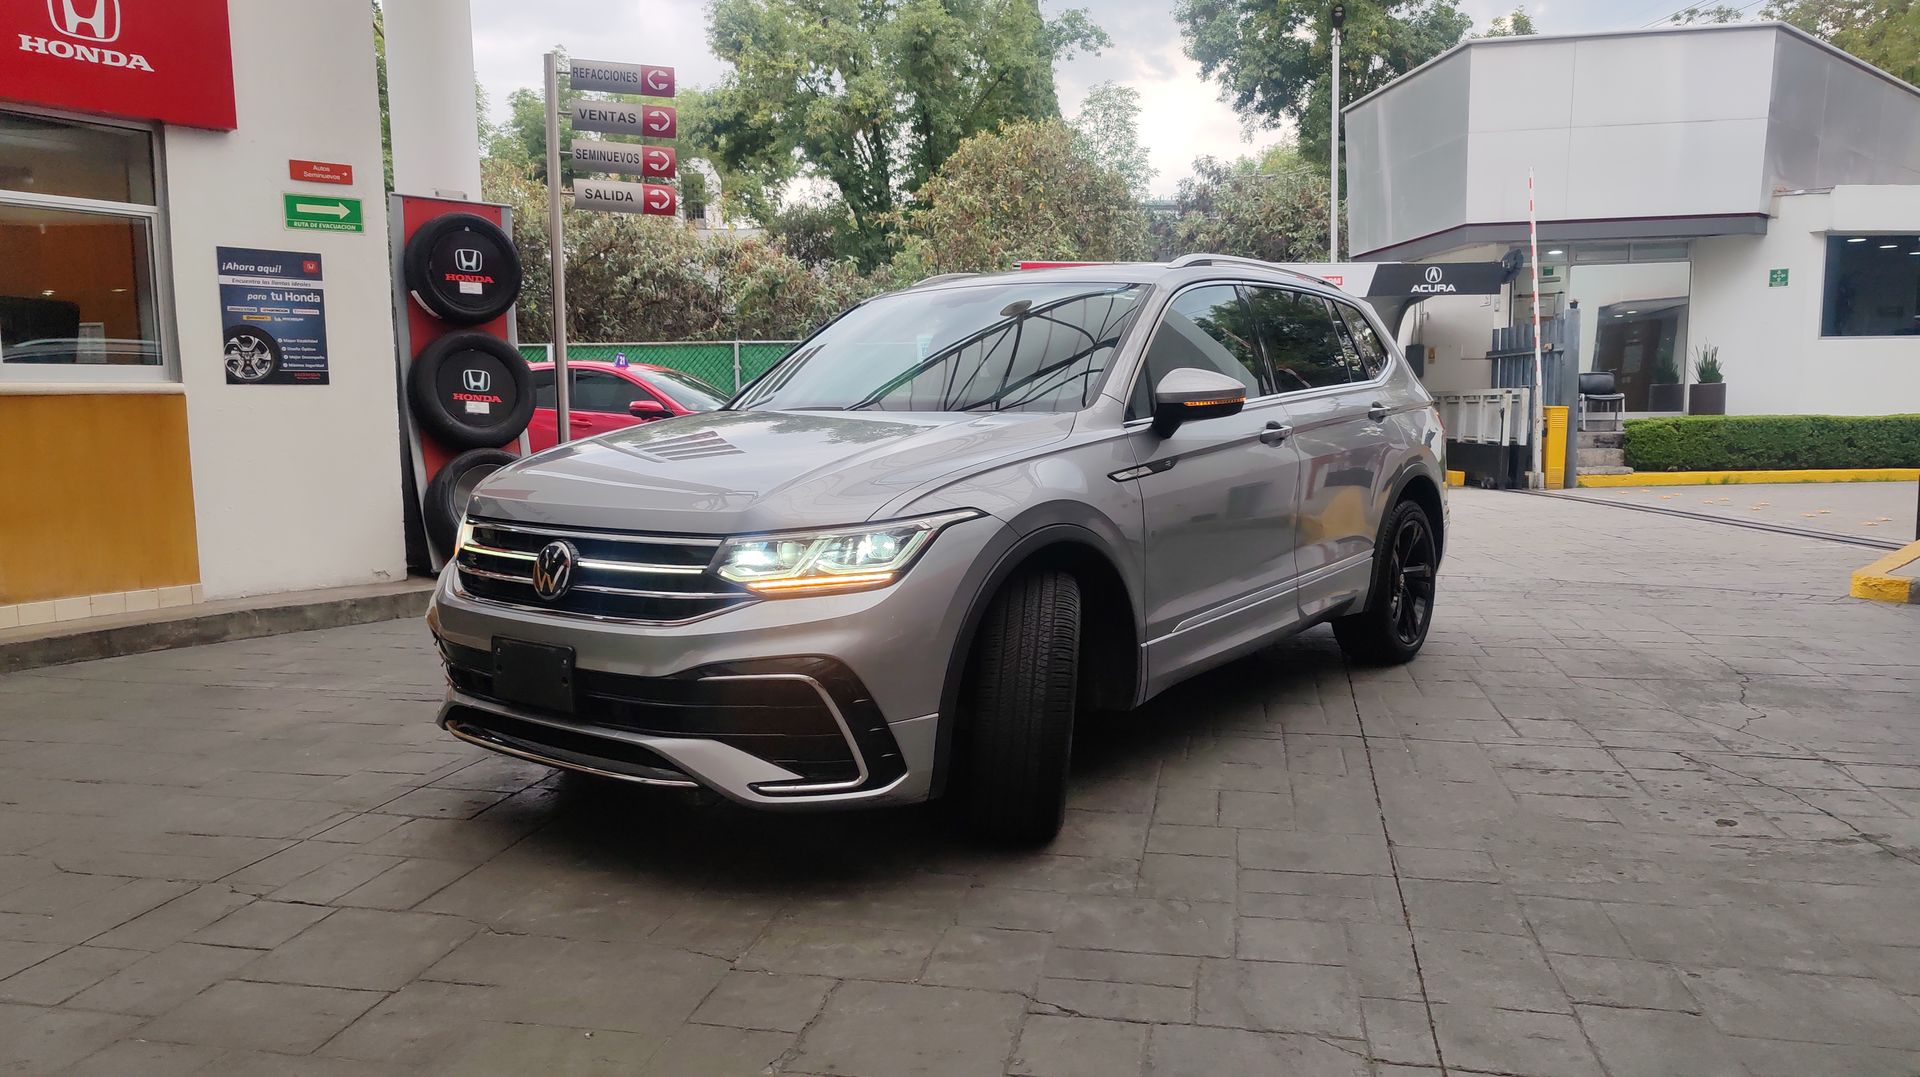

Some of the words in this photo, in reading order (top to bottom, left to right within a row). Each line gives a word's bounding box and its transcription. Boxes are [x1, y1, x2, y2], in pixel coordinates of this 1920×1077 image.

[17, 33, 155, 73] HONDA
[572, 67, 638, 83] REFACCIONES
[578, 108, 637, 124] VENTAS
[575, 148, 640, 164] SEMINUEVOS
[584, 188, 634, 202] SALIDA
[222, 262, 255, 271] ¡Ahora
[444, 273, 495, 284] HONDA
[1410, 284, 1456, 293] ACURA
[247, 293, 267, 301] para
[270, 291, 283, 301] tu
[285, 291, 321, 303] Honda
[452, 392, 502, 403] HONDA
